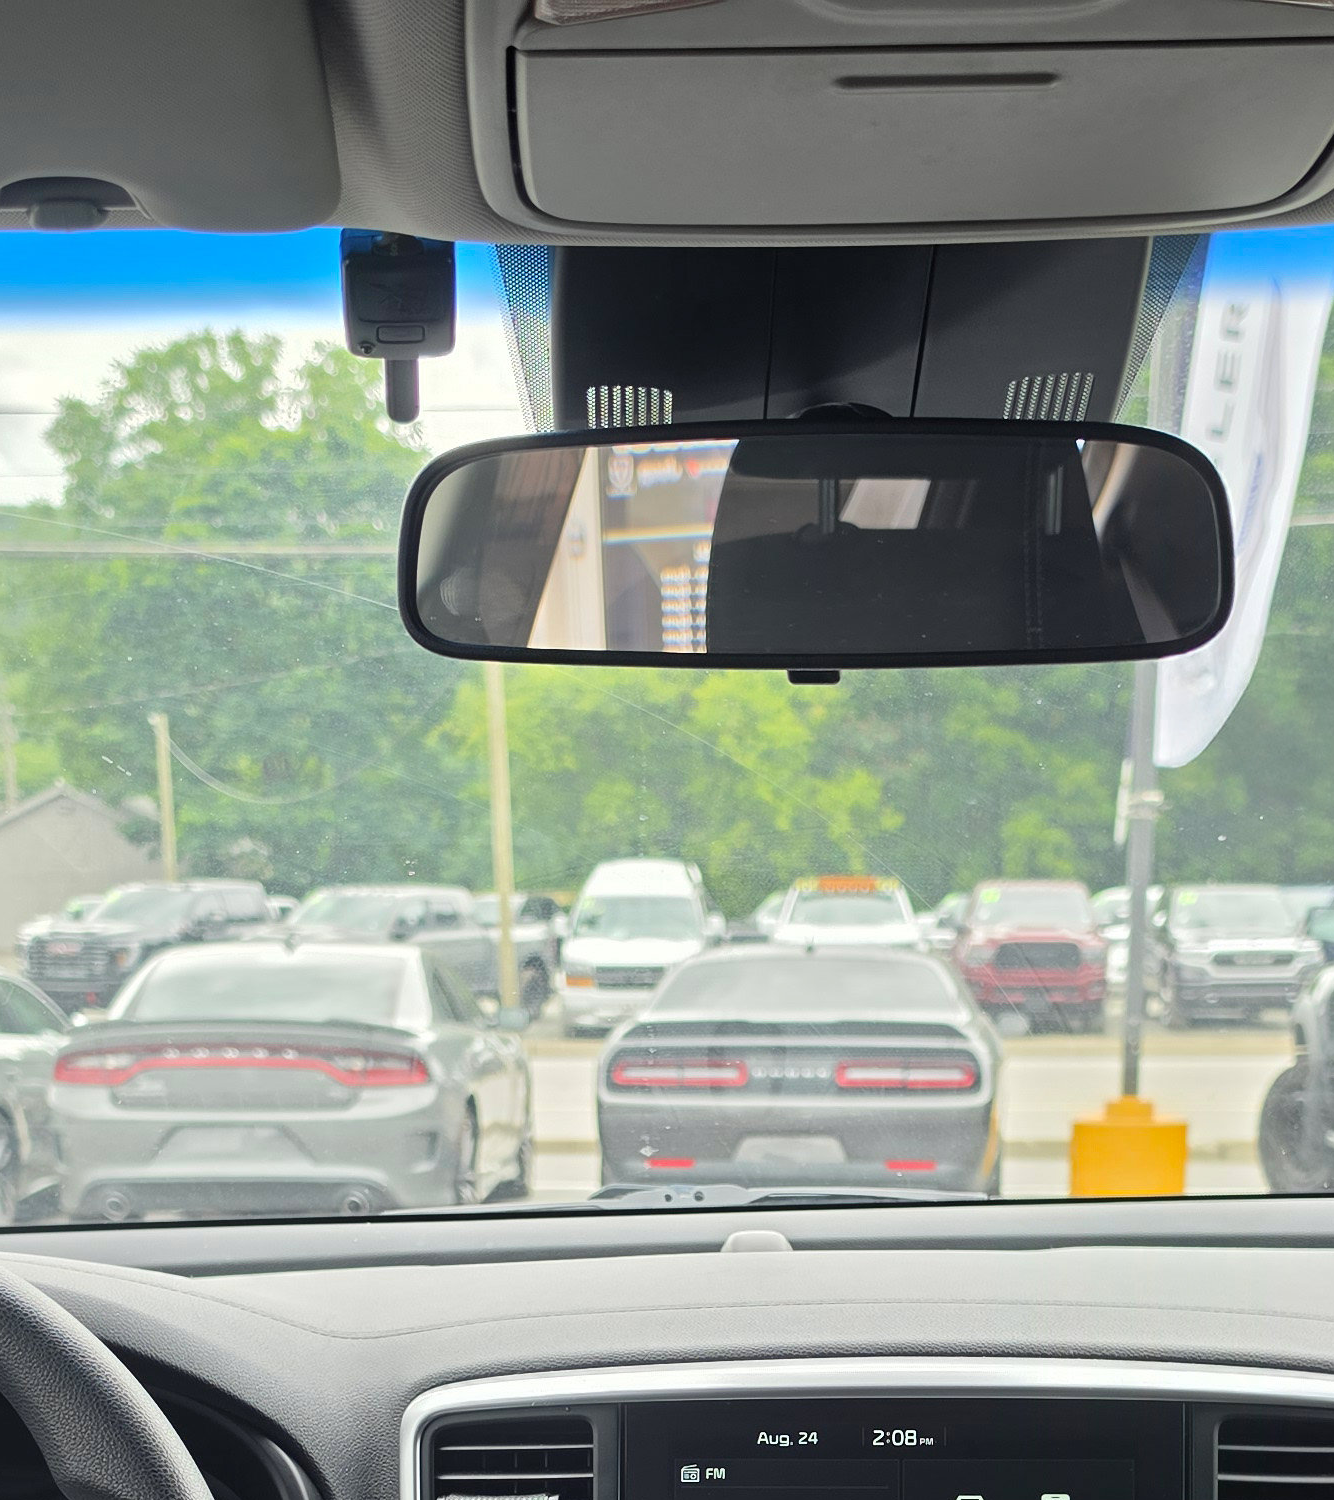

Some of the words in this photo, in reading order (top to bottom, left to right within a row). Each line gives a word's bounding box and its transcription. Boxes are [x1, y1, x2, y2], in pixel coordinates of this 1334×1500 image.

[756, 1431, 794, 1449] Aug.
[798, 1430, 819, 1446] 24
[871, 1429, 918, 1447] 2:08
[918, 1437, 935, 1446] PM
[705, 1466, 727, 1481] FM
